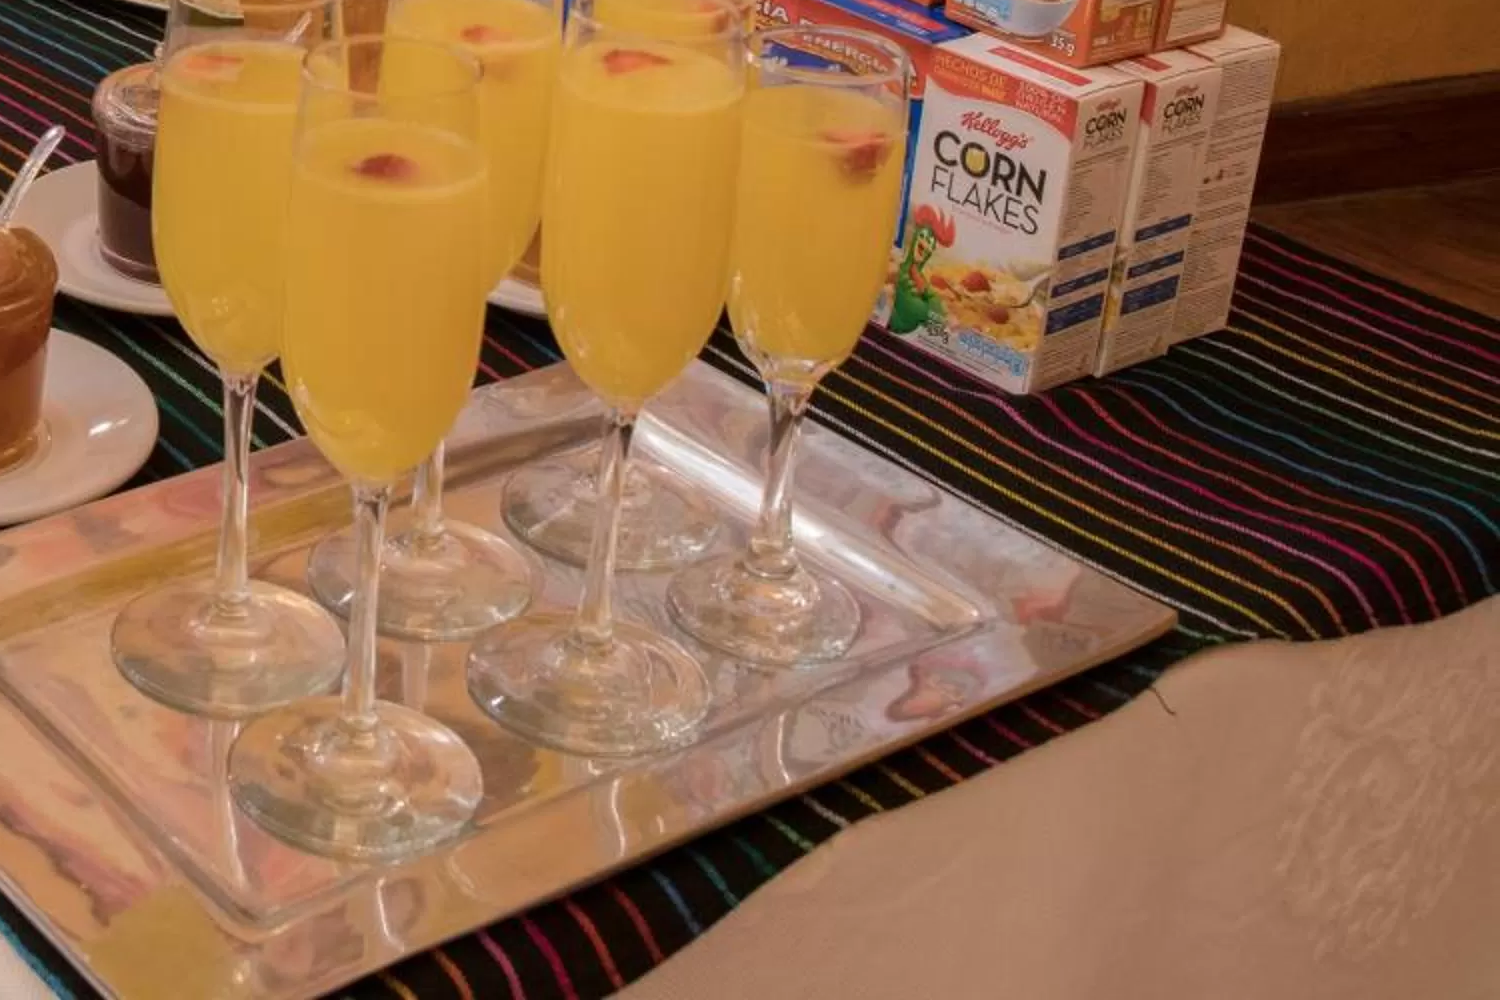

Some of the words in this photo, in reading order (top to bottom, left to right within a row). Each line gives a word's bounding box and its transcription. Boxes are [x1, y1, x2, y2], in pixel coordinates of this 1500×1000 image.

[1085, 107, 1127, 135] CORN
[1164, 93, 1205, 119] CORN
[961, 111, 1028, 151] Kellogg's
[933, 130, 1047, 205] CORN
[931, 165, 1040, 236] FLAKES
